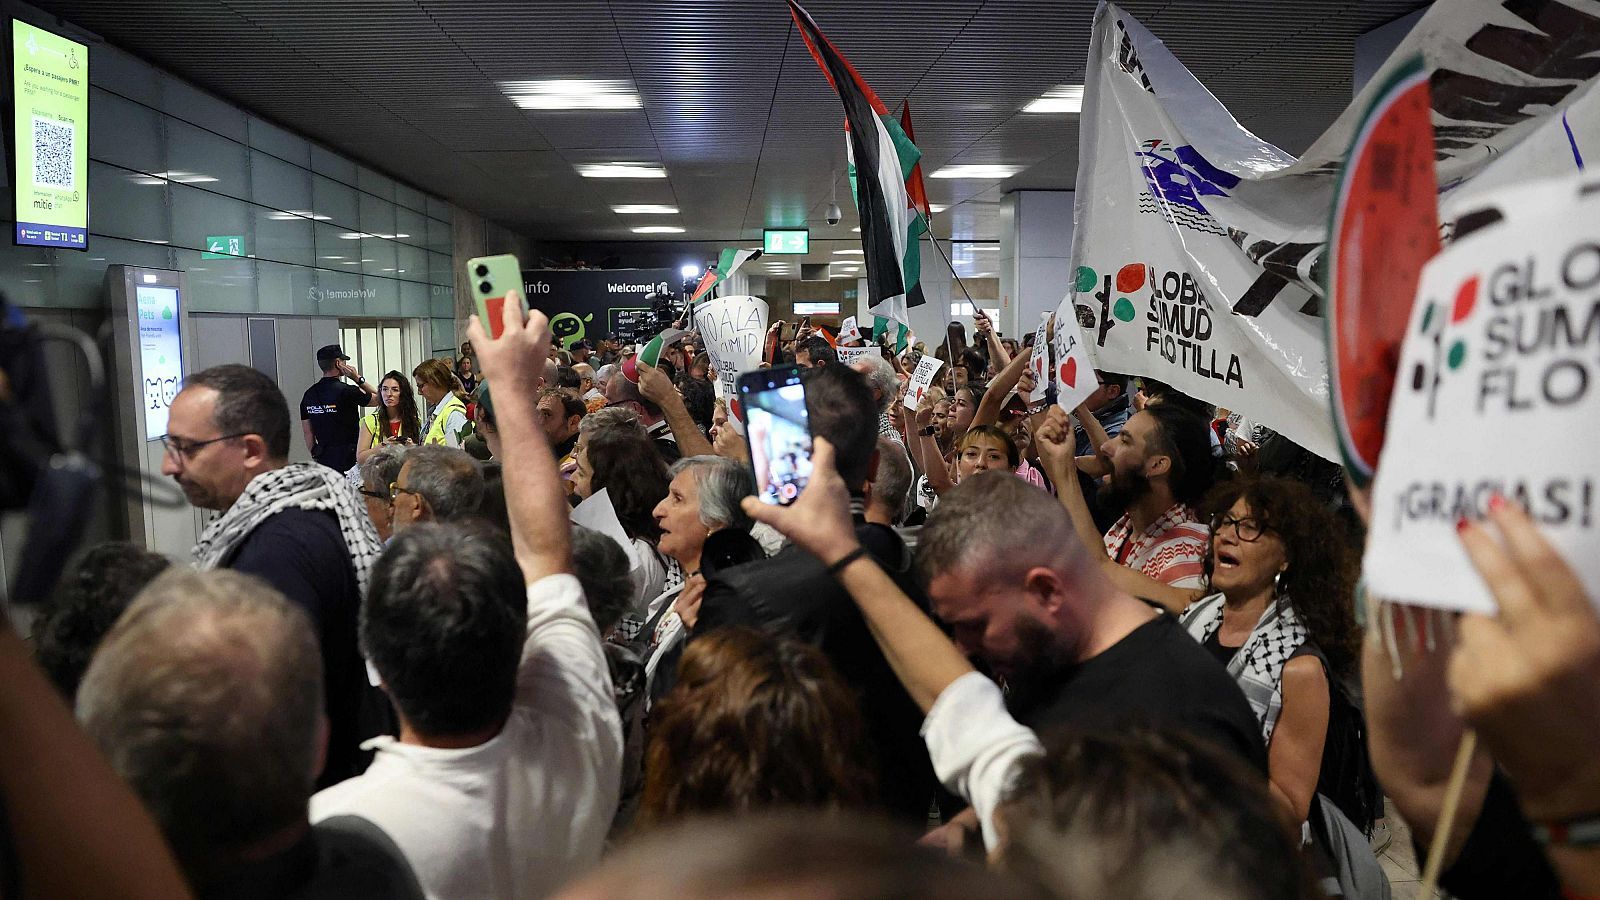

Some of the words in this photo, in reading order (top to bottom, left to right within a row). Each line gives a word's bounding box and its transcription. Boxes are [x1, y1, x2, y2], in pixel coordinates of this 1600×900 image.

[33, 198, 53, 210] mitie
[60, 232, 68, 242] T1
[525, 280, 550, 294] info
[607, 282, 655, 294] Welcome!
[139, 308, 155, 320] Pets
[1146, 327, 1244, 389] FLOTILLA
